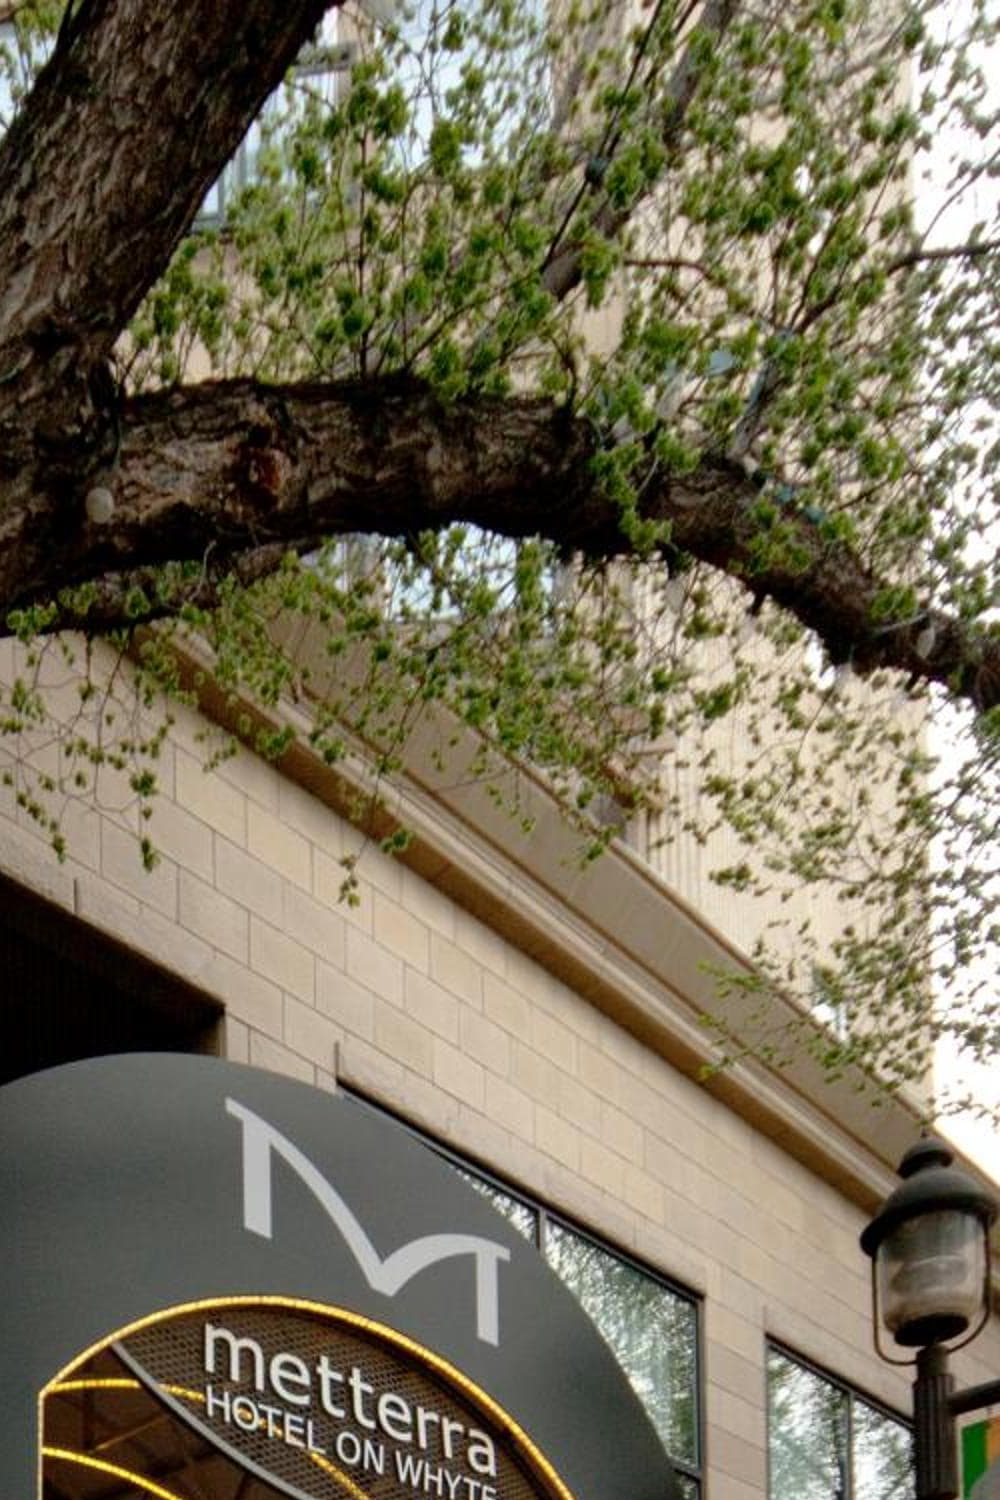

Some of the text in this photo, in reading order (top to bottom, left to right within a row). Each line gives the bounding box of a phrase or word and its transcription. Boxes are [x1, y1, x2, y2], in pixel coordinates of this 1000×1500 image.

[203, 1322, 498, 1477] metterra
[205, 1385, 325, 1457] HOTEL
[336, 1431, 385, 1475] ON
